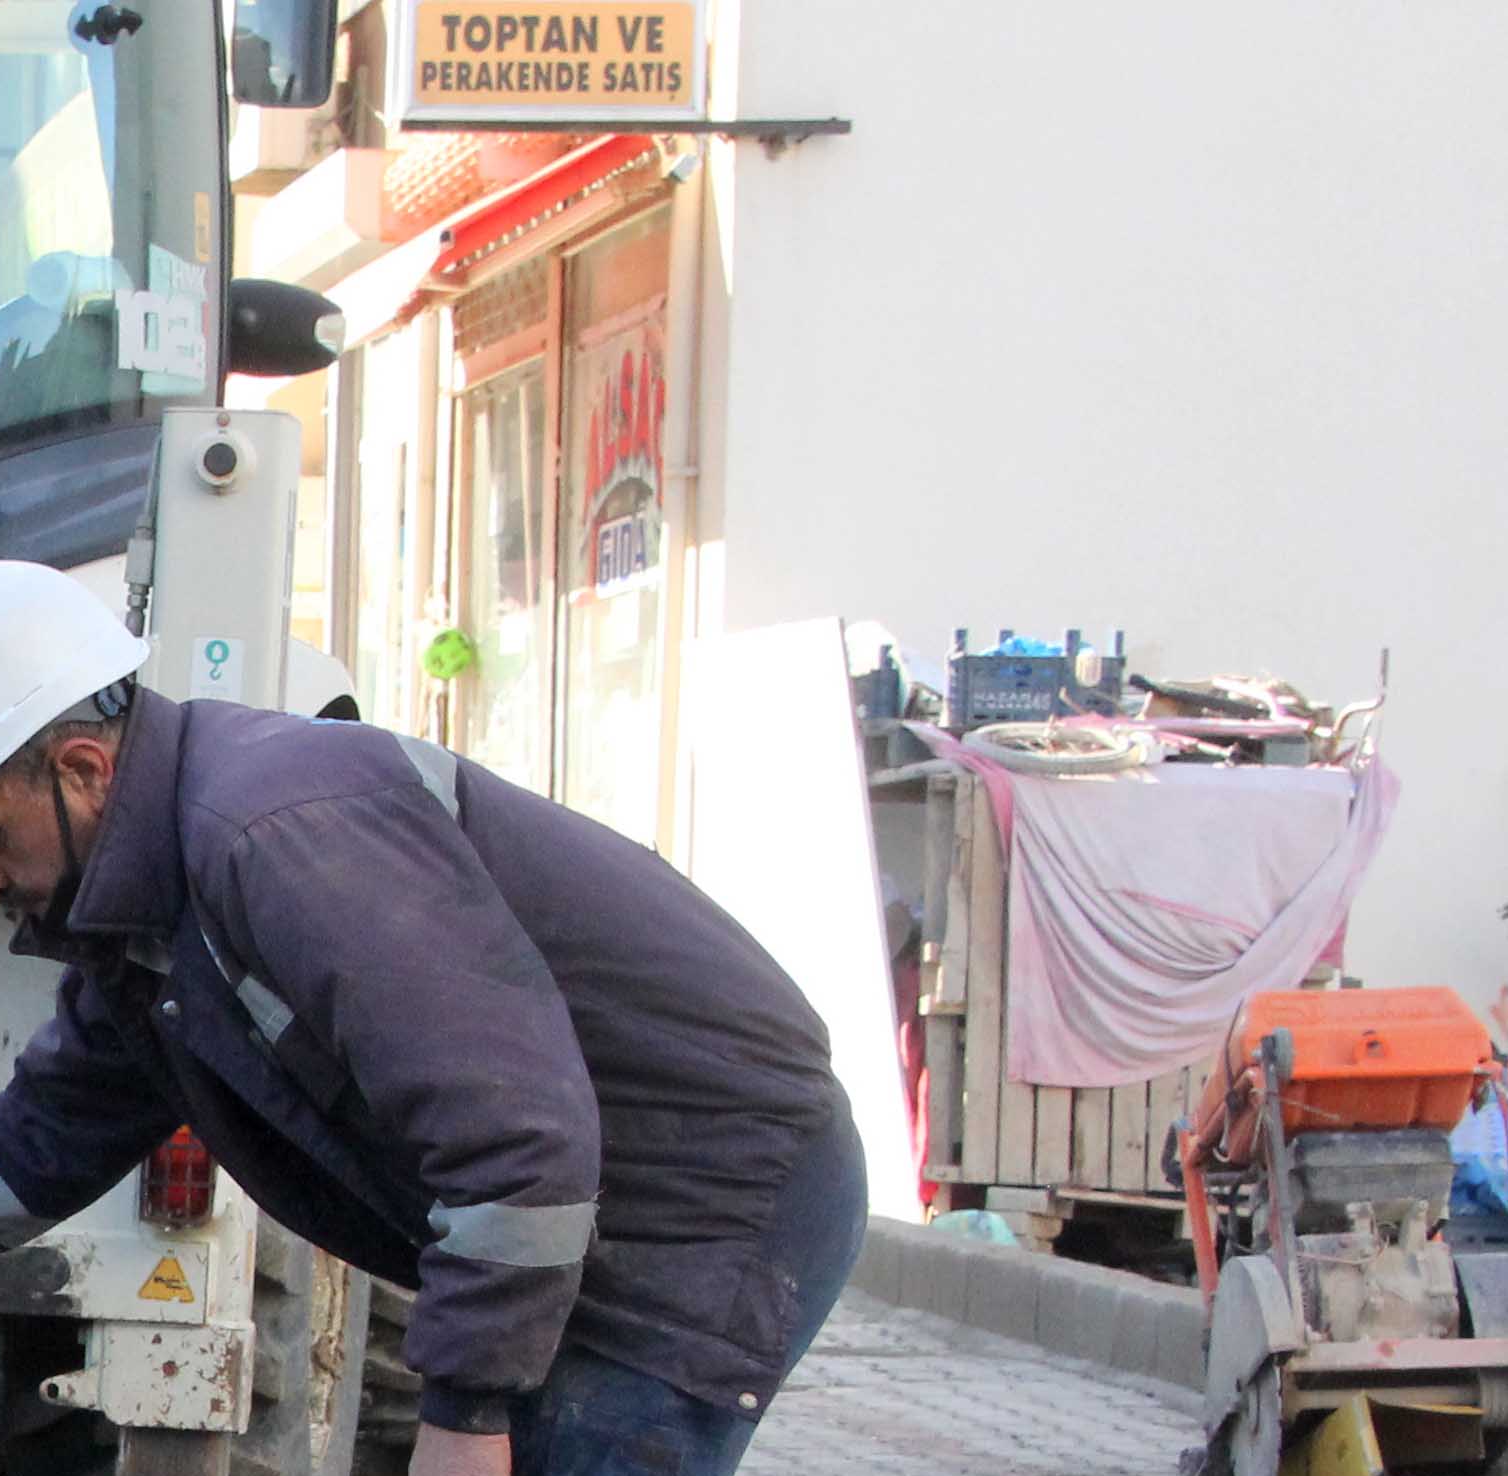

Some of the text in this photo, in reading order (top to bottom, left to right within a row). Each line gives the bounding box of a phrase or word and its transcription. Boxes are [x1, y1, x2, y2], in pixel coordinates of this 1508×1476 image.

[441, 14, 665, 53] TOPTAN VE
[421, 61, 683, 101] PERAKENDE SATIŞ
